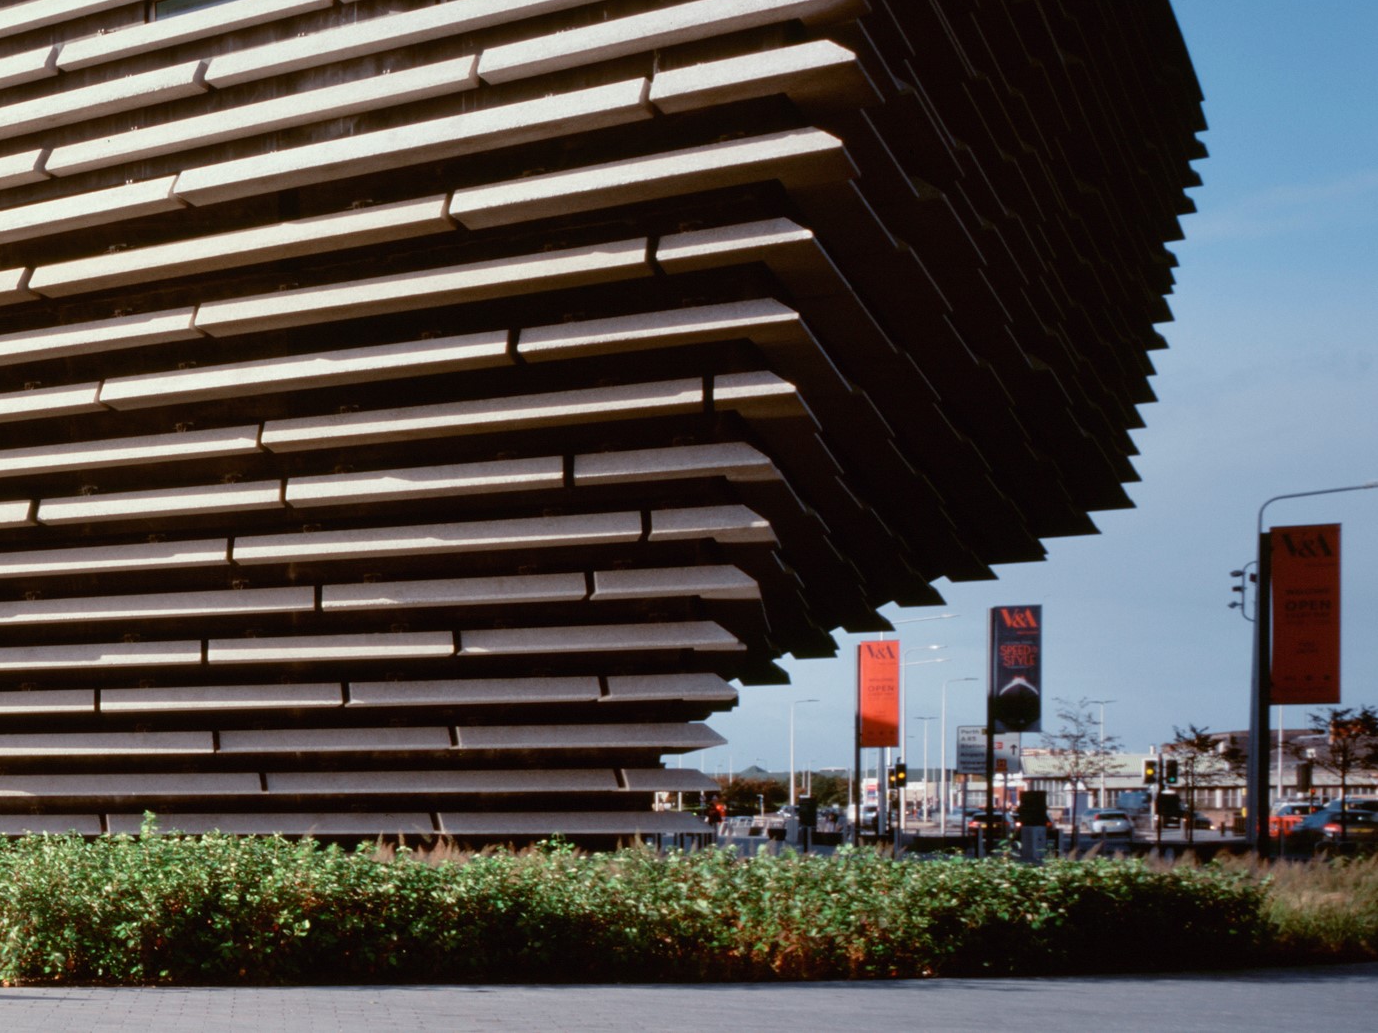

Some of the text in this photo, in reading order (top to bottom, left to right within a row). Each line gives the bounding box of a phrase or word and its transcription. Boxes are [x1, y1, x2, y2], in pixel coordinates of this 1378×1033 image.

[1283, 534, 1332, 558] V&A
[1285, 600, 1331, 612] OPEN
[1001, 608, 1037, 627] V&A
[866, 644, 895, 660] V&A
[1001, 645, 1031, 655] SPEED
[1004, 656, 1035, 666] STYLE
